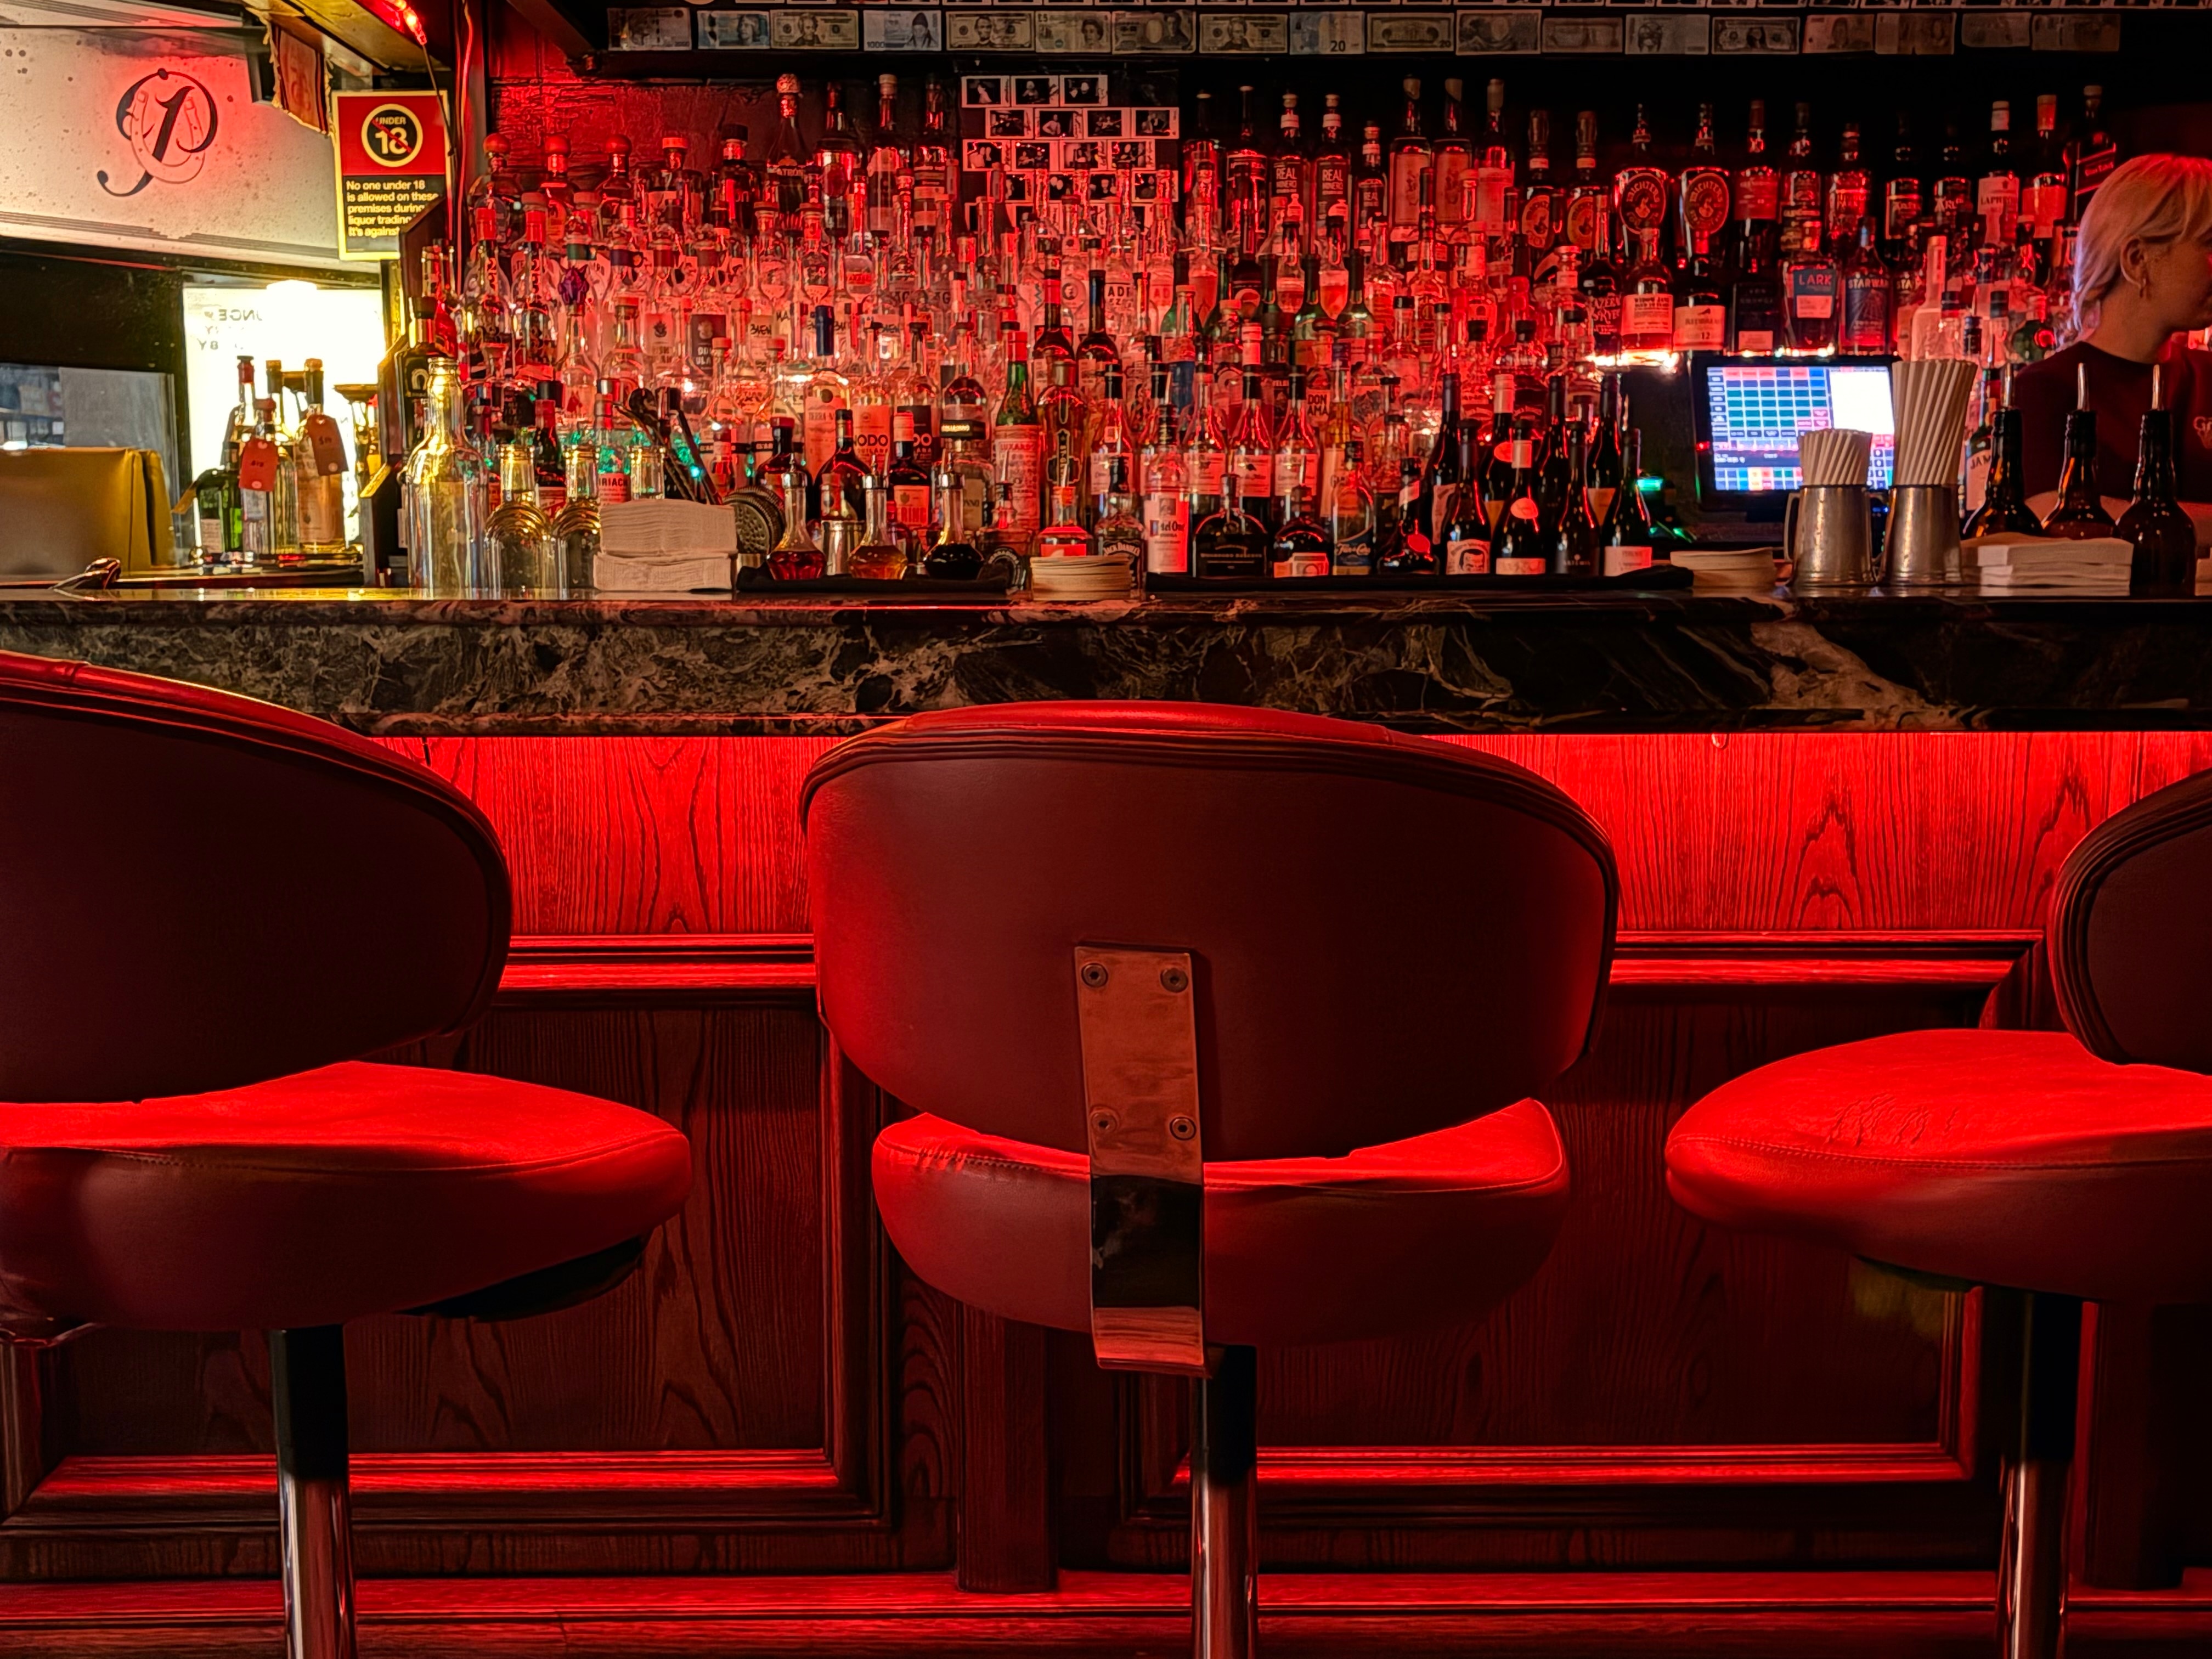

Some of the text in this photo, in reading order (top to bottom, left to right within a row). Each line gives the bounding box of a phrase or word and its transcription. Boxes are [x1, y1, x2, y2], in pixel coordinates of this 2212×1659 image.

[1330, 41, 1346, 52] 20
[375, 127, 408, 154] 18
[1276, 168, 1297, 180] REAL
[1322, 169, 1344, 181] REAL
[346, 180, 425, 190] No one under 18
[347, 193, 356, 202] is
[357, 192, 394, 201] allowed
[397, 193, 409, 201] on
[347, 204, 392, 215] premises
[348, 215, 376, 225] liquor
[1798, 274, 1833, 286] LARK
[1701, 331, 1711, 340] 12
[1307, 394, 1327, 405] DON
[1104, 545, 1118, 555] JACK
